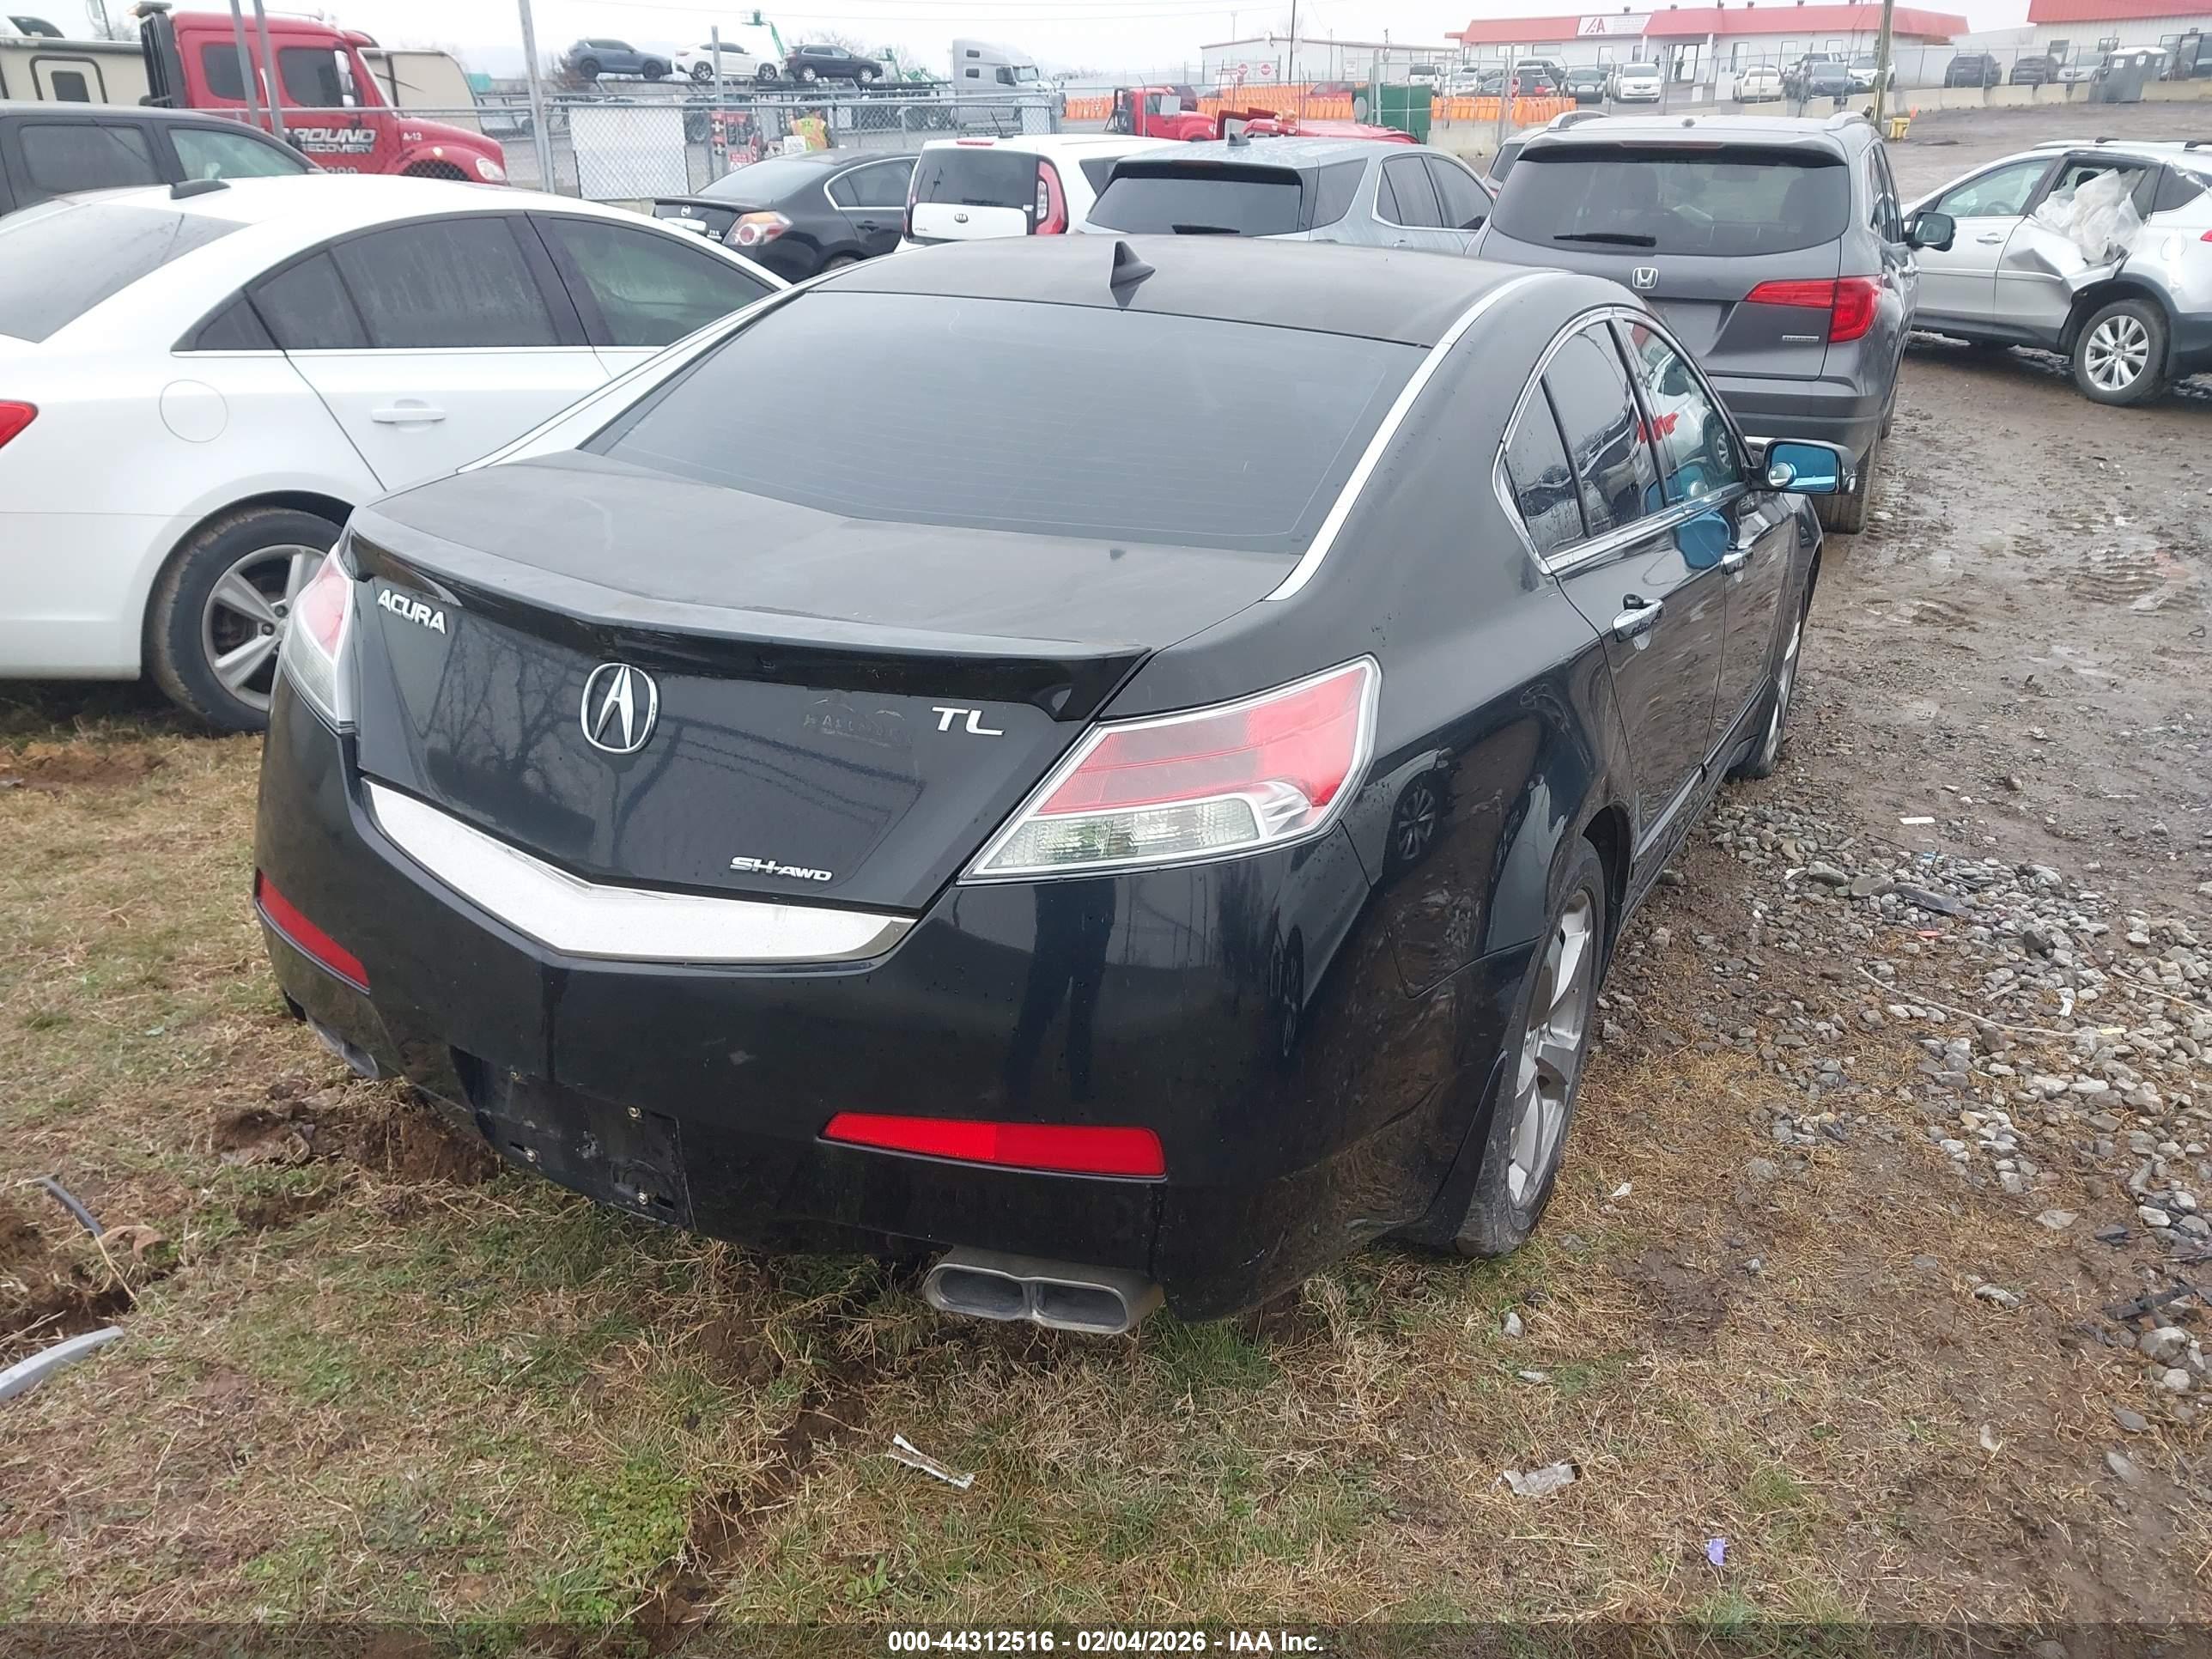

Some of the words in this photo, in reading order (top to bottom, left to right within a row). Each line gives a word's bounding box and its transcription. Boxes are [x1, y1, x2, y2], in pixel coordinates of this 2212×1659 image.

[283, 127, 376, 143] ROUND
[378, 589, 447, 635] ACURA
[932, 706, 1005, 736] TL
[730, 856, 833, 882] SH-AWD
